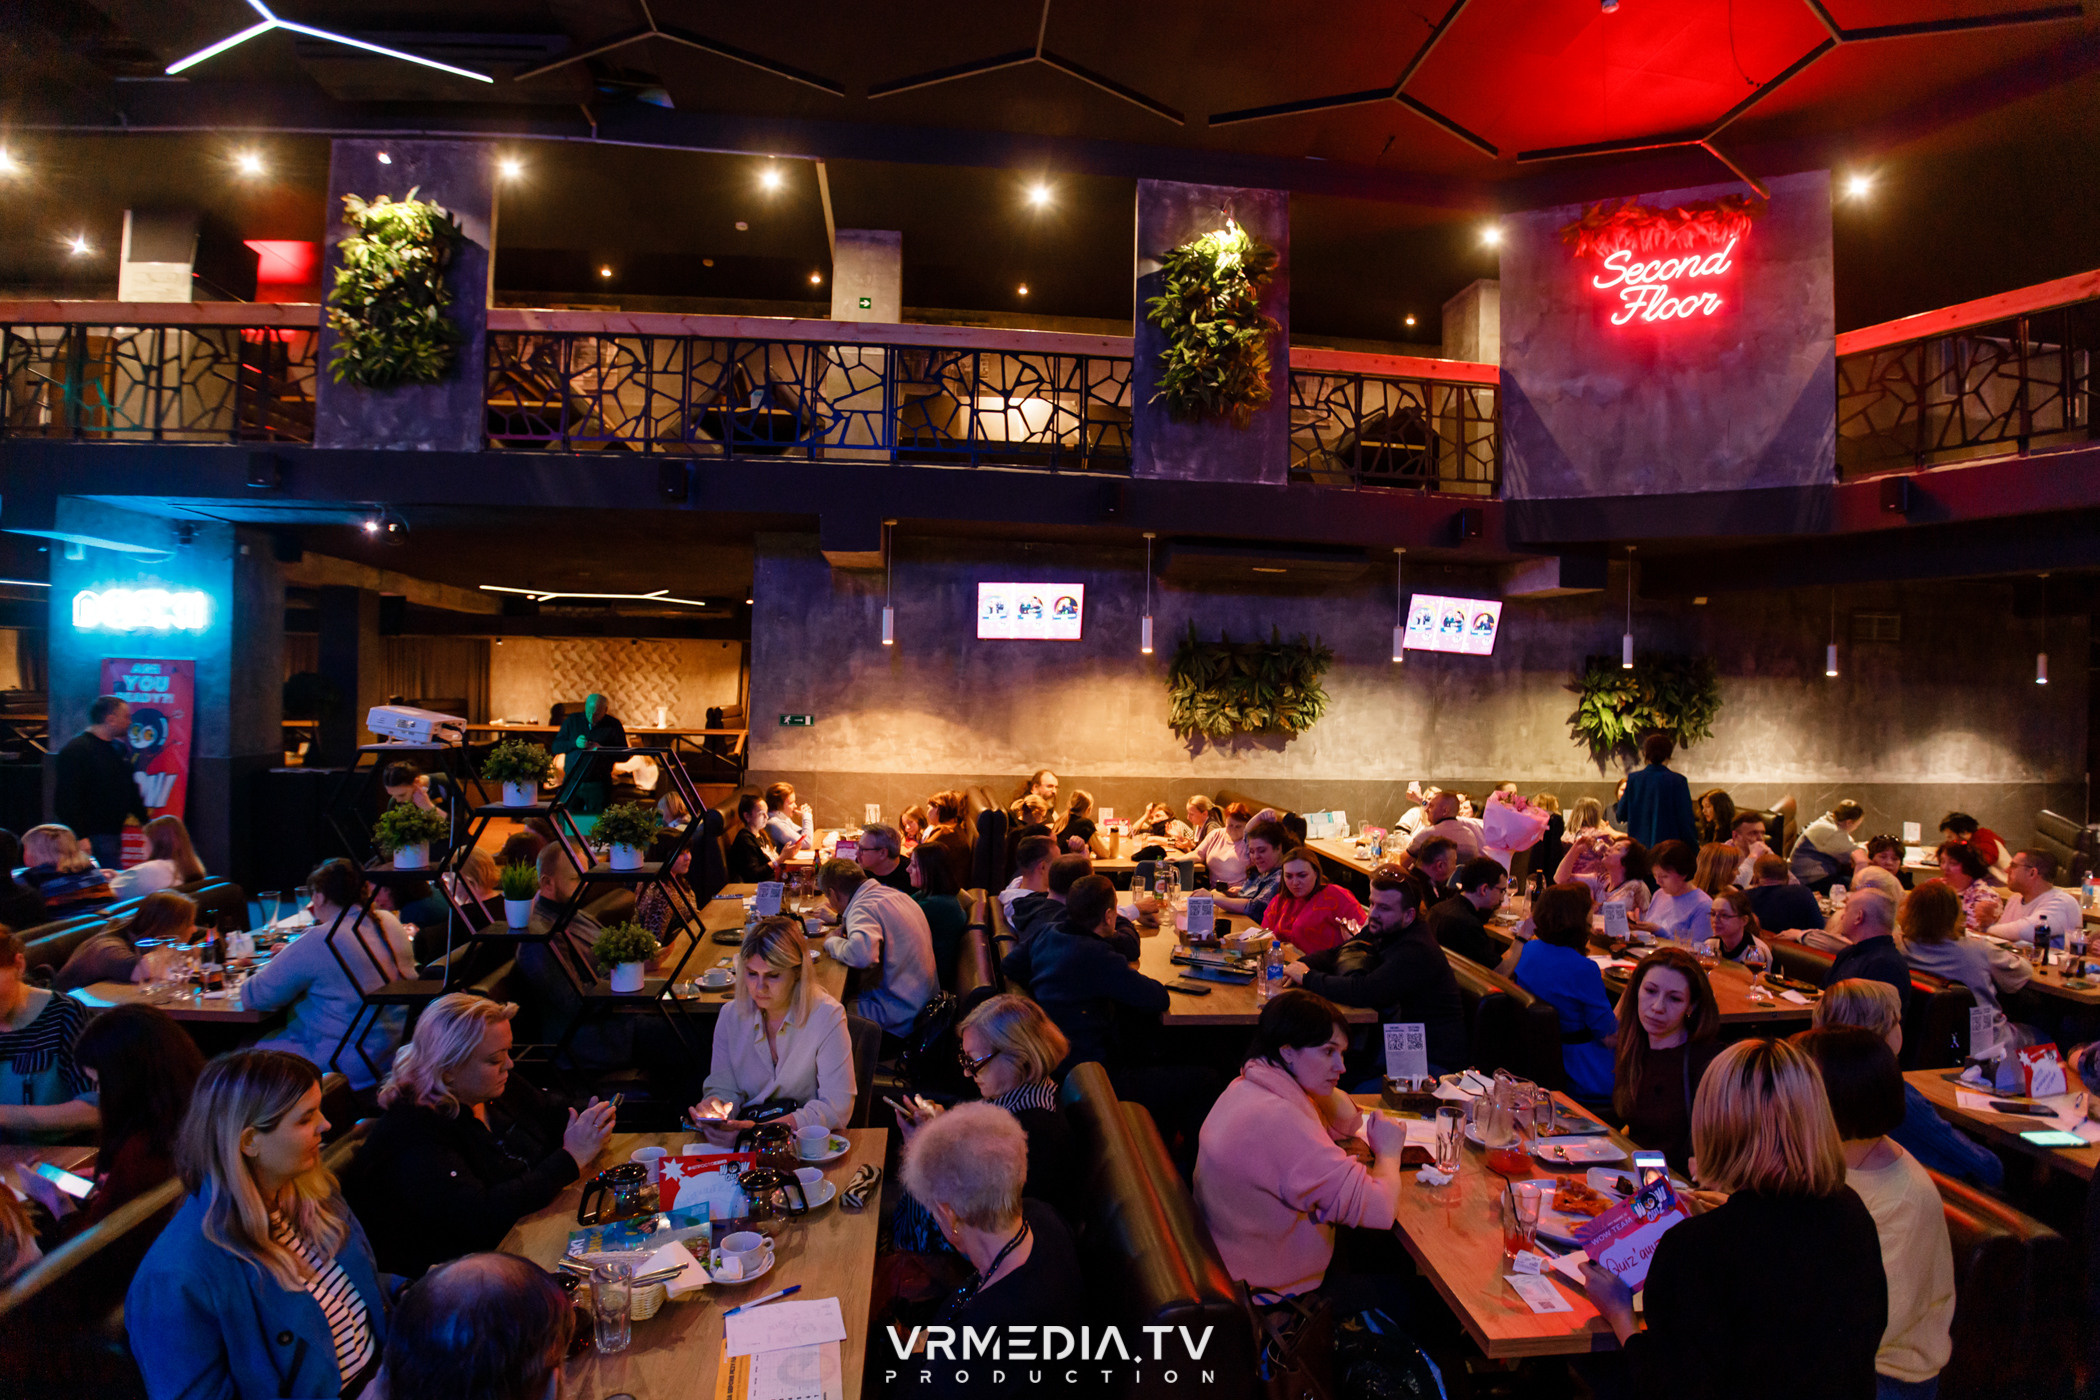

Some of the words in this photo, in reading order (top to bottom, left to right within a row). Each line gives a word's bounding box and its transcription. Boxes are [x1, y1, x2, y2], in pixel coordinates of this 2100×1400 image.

[1593, 236, 1738, 289] Second
[1611, 284, 1723, 326] Floor
[122, 675, 170, 692] YOU
[1646, 1202, 1666, 1222] QUIZ
[1591, 1230, 1612, 1246] WOW
[1611, 1216, 1633, 1233] TEAM
